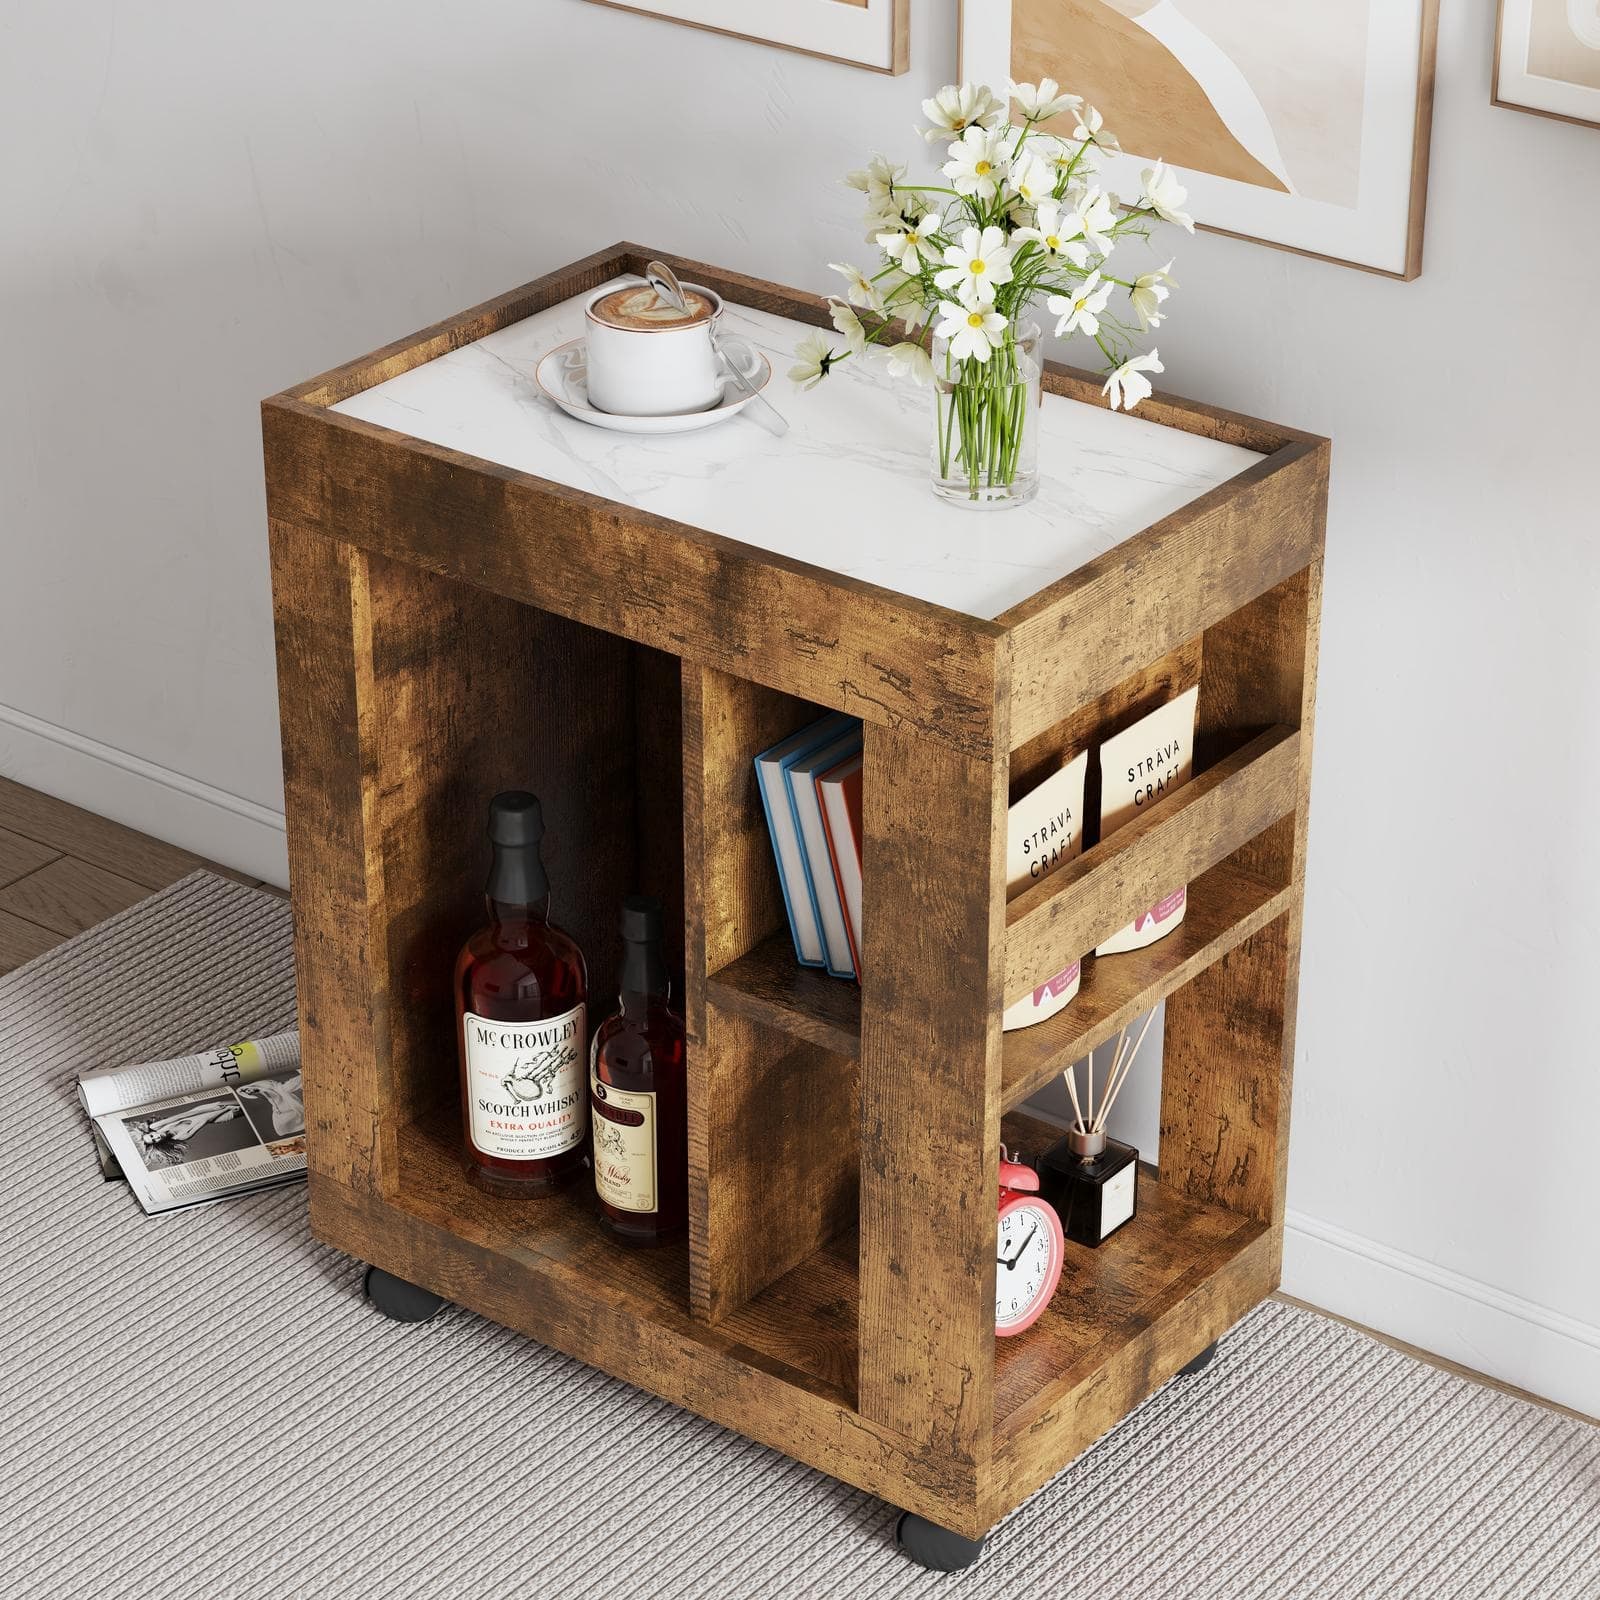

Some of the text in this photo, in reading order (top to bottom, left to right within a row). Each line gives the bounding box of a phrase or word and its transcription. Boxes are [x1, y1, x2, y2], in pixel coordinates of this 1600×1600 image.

[1134, 764, 1181, 806] CRAFT
[1030, 832, 1072, 878] CRAFT
[500, 1016, 580, 1049] CROWLEY
[478, 1098, 529, 1117] SCOTCH
[534, 1090, 580, 1116] WHISKY
[489, 1120, 524, 1131] EXTRA
[528, 1113, 573, 1131] QUALITY
[1002, 1216, 1011, 1232] 12
[1037, 1238, 1044, 1251] 3
[1026, 1281, 1033, 1294] 5
[1011, 1297, 1018, 1310] 6
